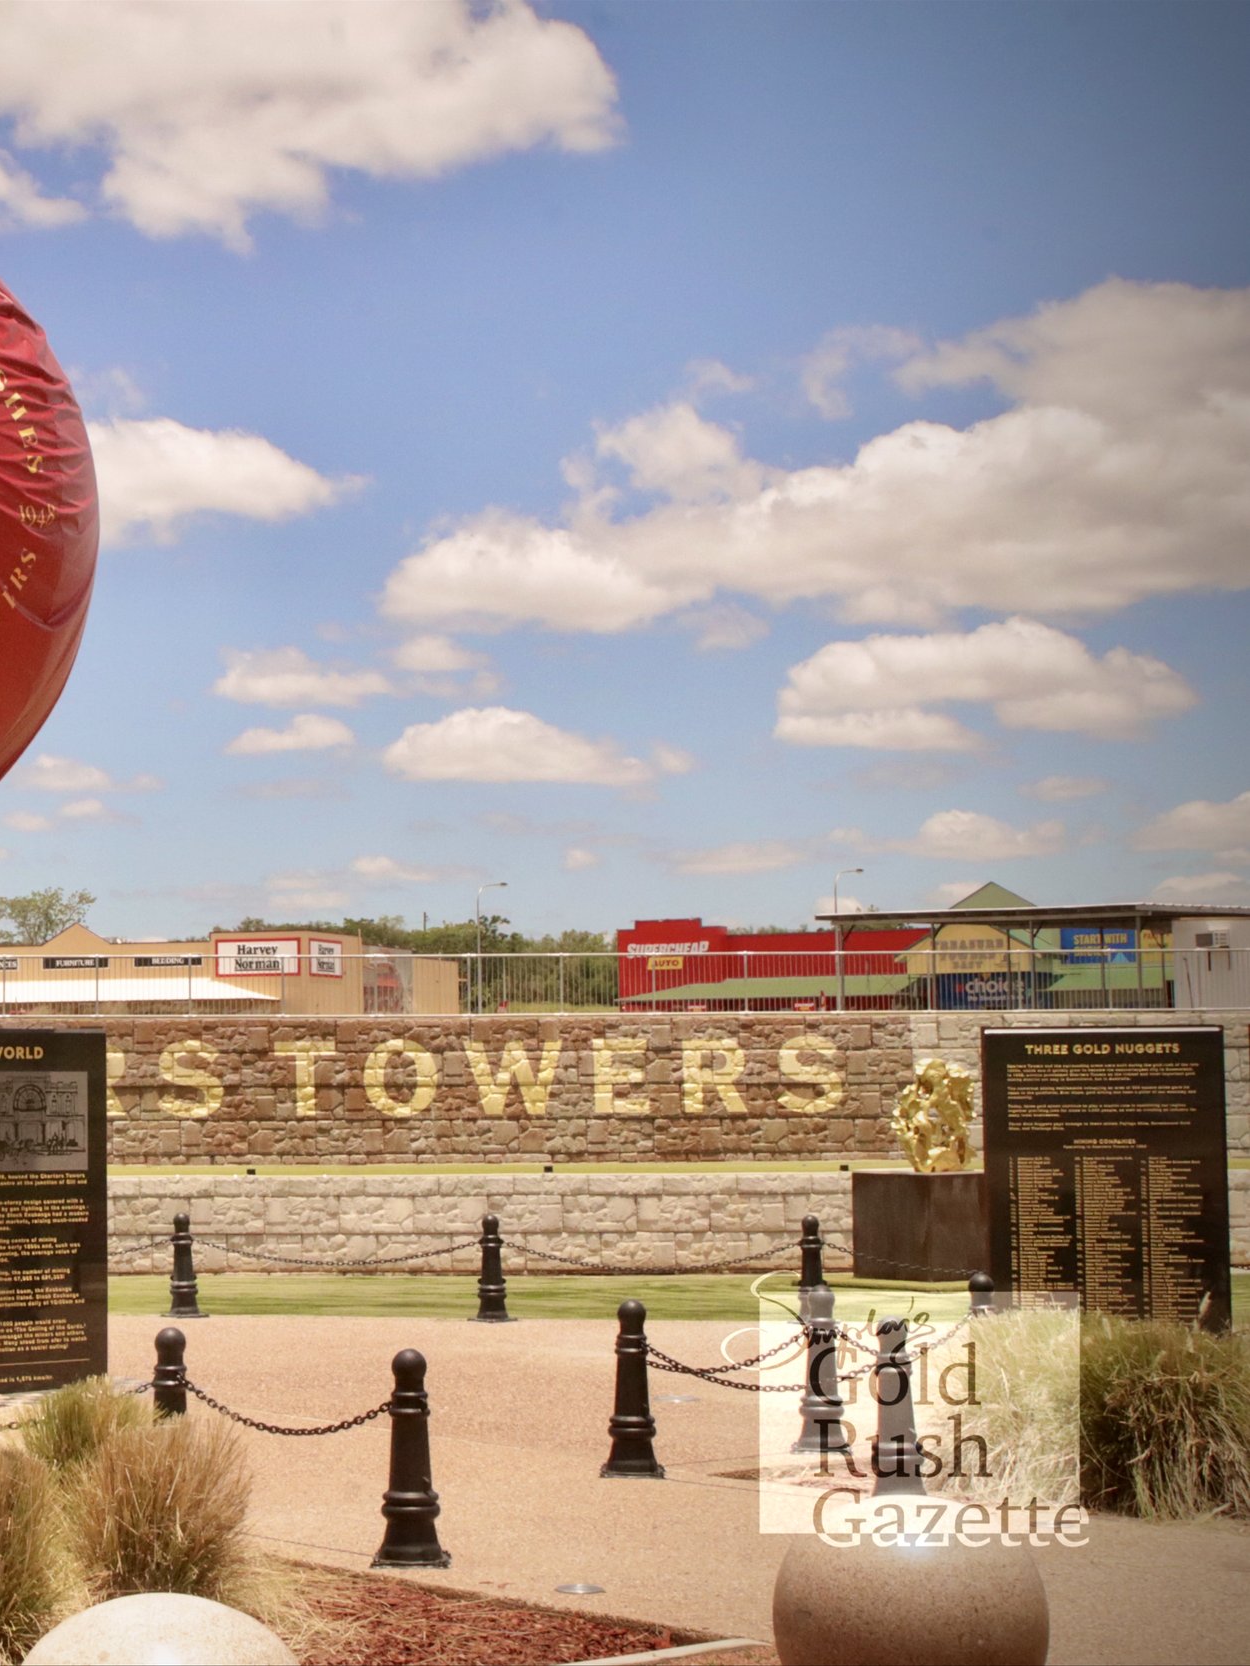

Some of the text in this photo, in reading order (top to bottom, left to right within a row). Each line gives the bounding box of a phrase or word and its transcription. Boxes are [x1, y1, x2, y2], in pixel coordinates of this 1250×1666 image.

[237, 944, 278, 956] Harvey
[627, 941, 710, 958] SUPERCHEAP
[56, 958, 95, 967] FURNITURE
[234, 959, 280, 969] Norman
[1025, 1043, 1180, 1055] THREE GOLD NUGGETS
[274, 1035, 847, 1118] TOWERS
